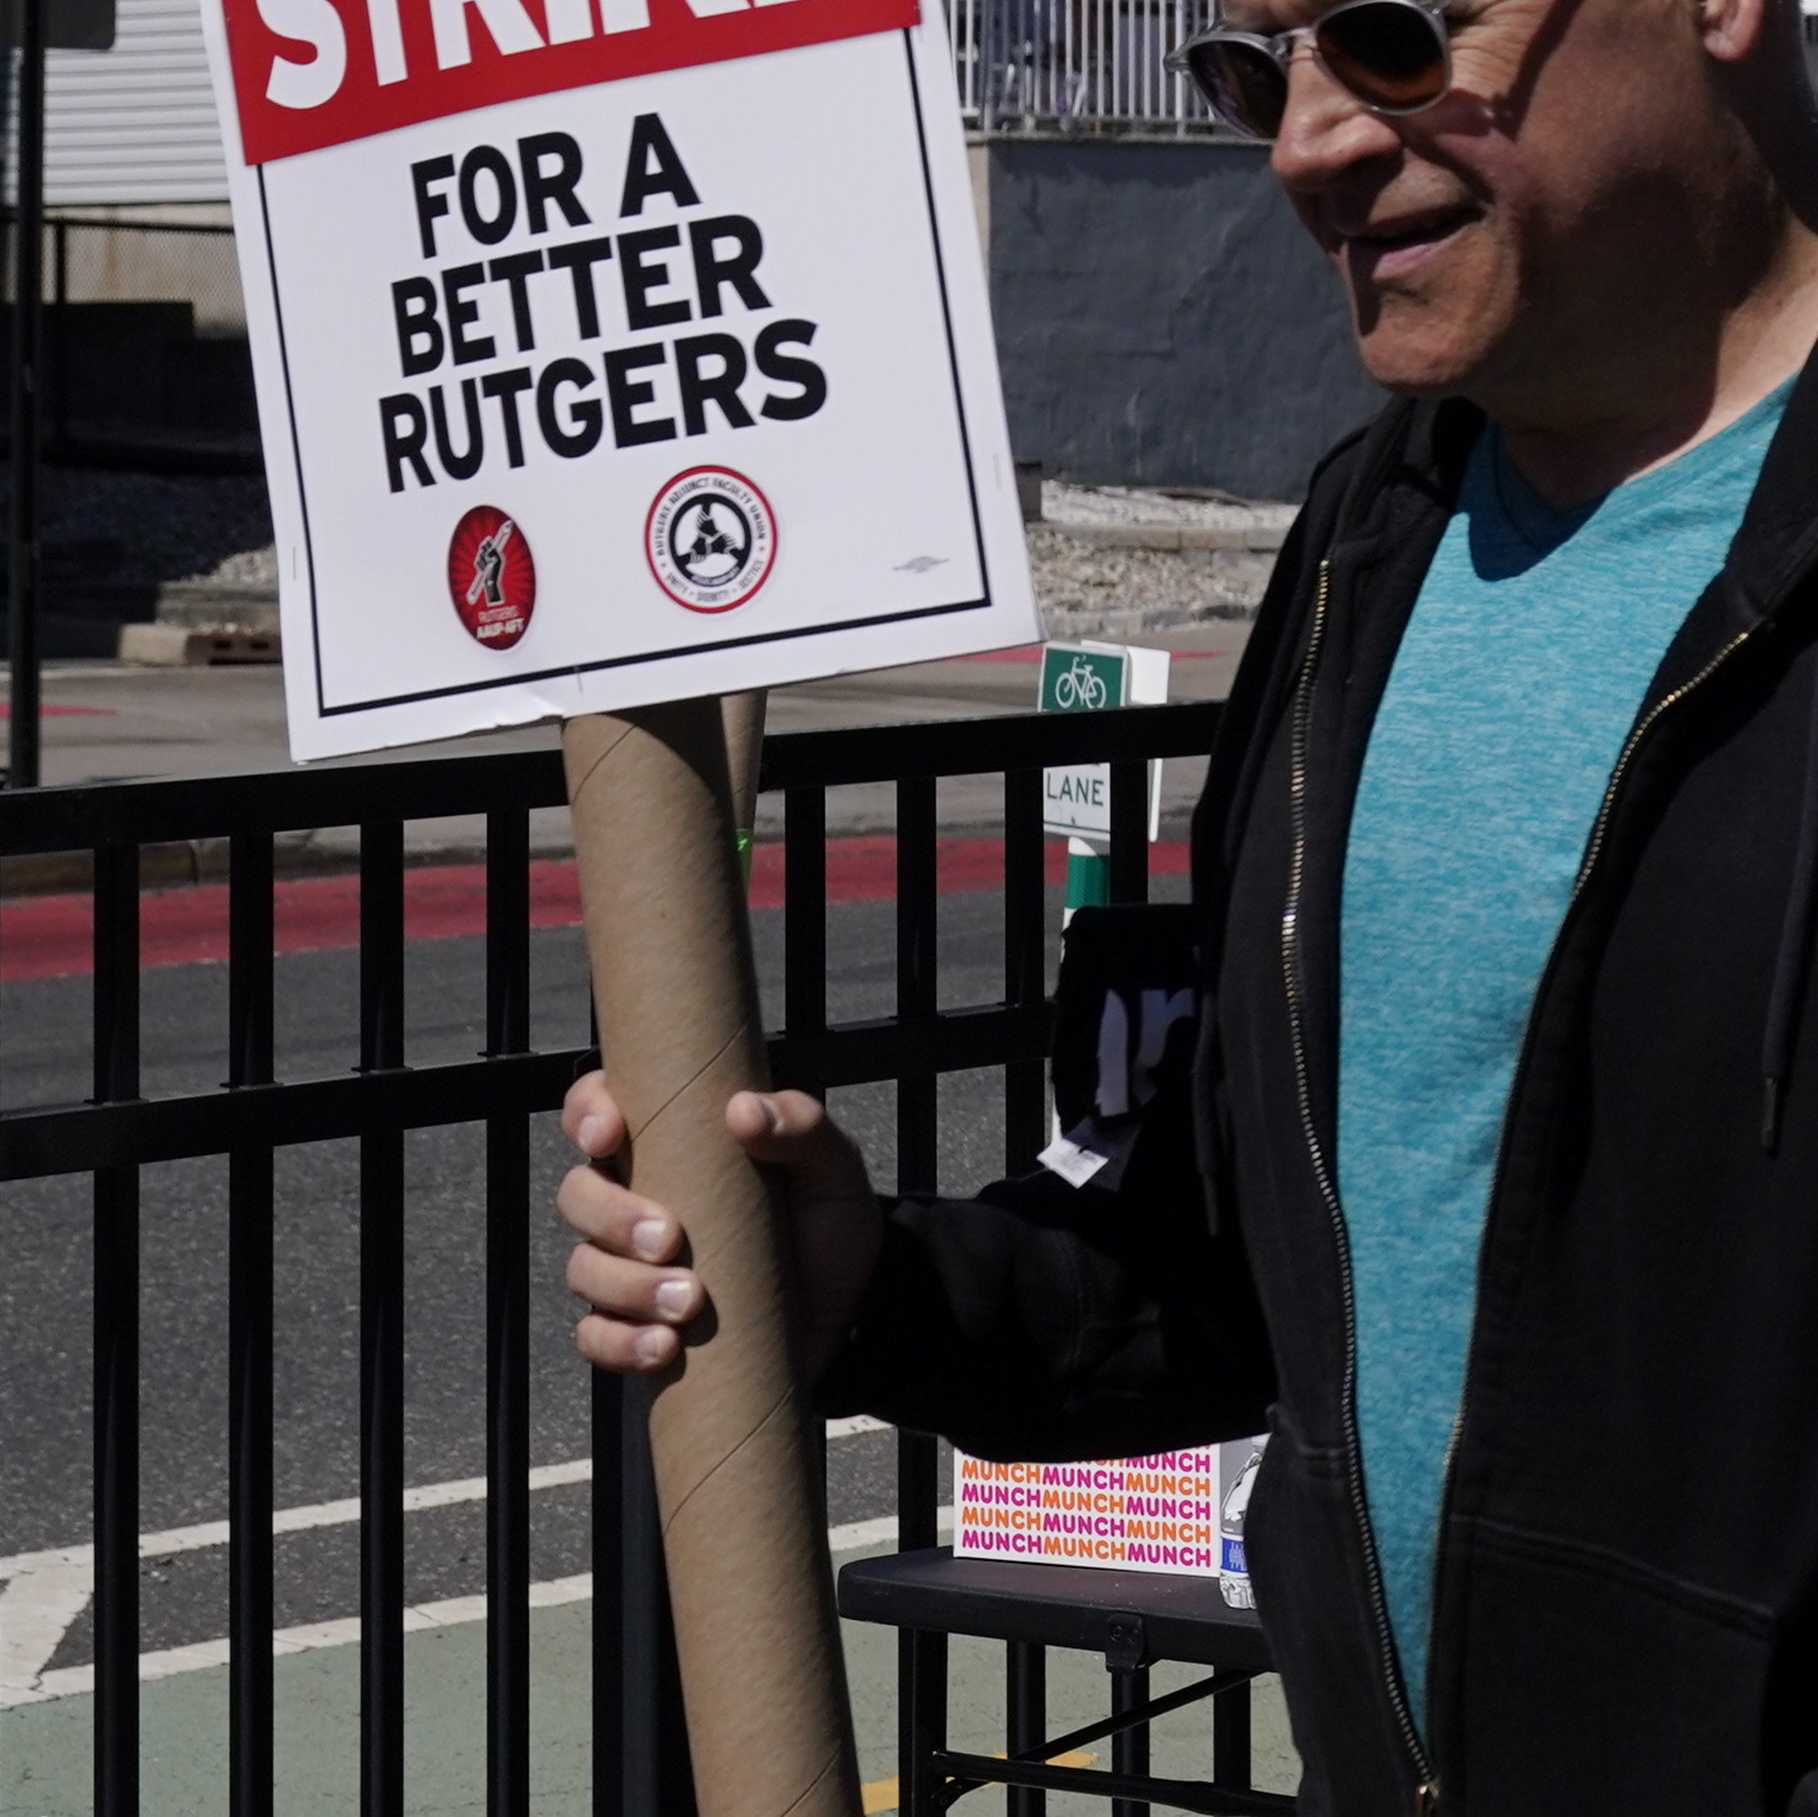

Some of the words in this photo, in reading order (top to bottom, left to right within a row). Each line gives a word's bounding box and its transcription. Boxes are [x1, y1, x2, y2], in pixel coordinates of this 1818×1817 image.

[414, 130, 592, 259] FOR
[620, 113, 700, 220] A
[392, 214, 771, 379] BETTER
[380, 318, 829, 494] RUTGERS
[1047, 772, 1104, 806] LANE
